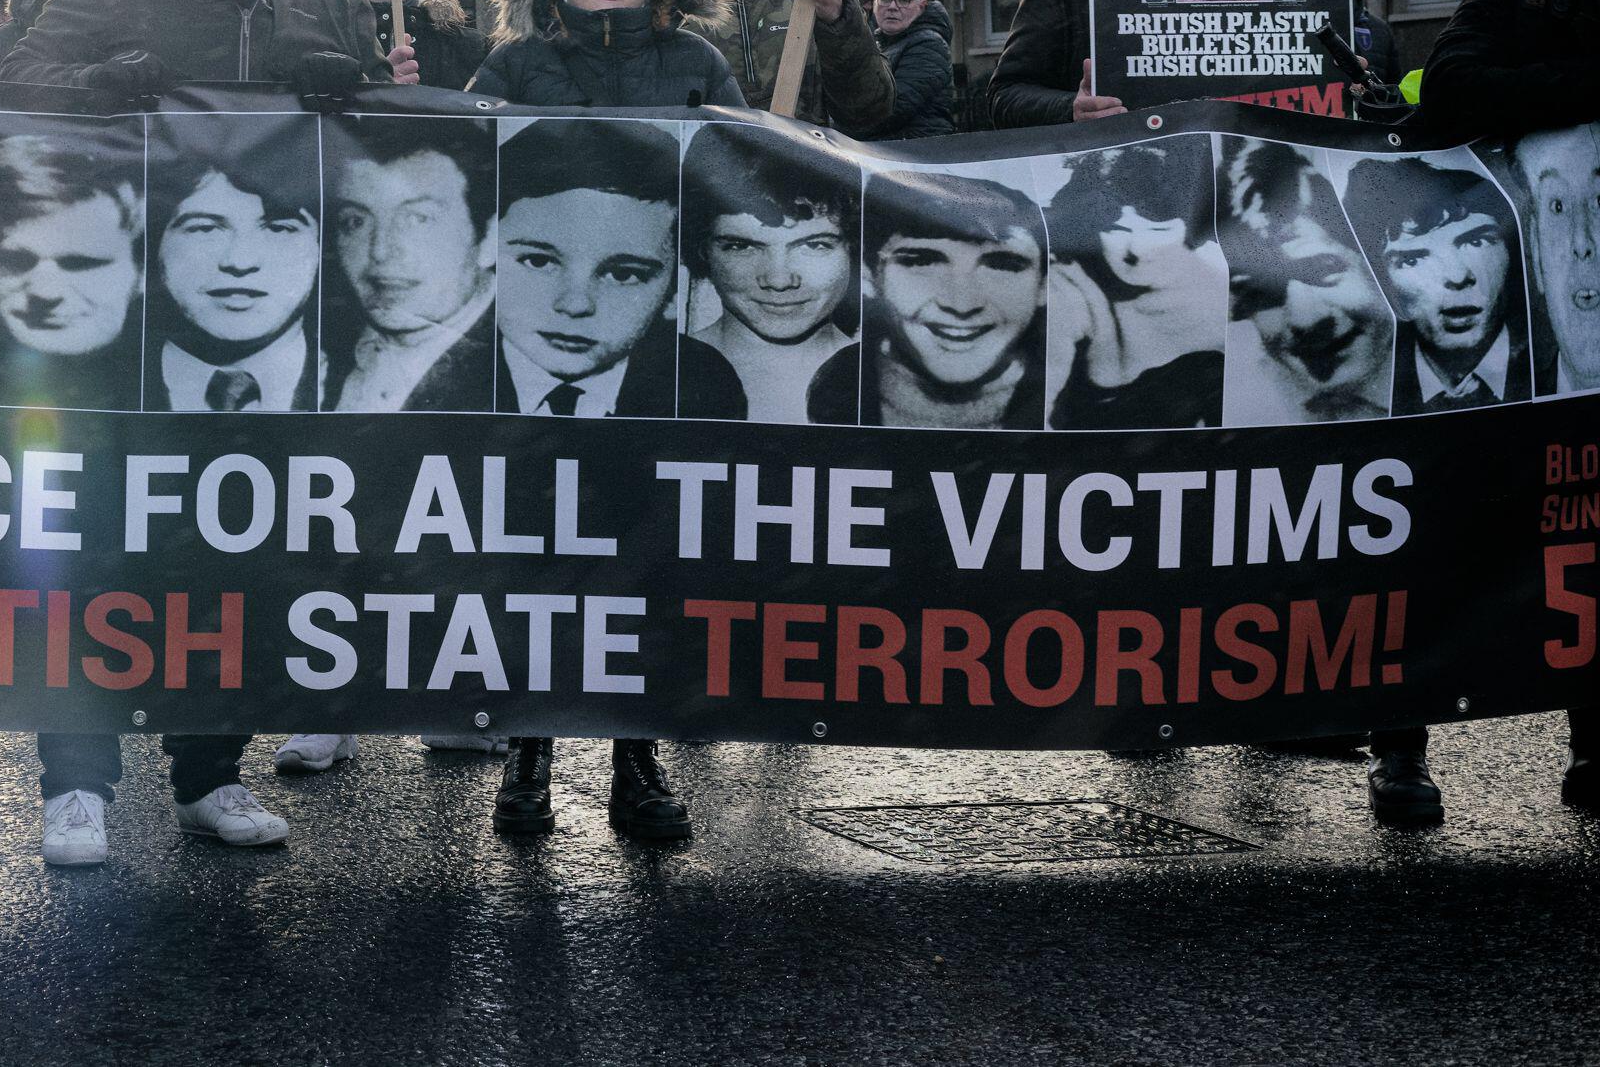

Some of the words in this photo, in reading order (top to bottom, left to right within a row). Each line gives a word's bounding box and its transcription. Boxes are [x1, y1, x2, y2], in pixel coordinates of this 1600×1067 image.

[1117, 13, 1223, 35] BRITISH
[1141, 34, 1250, 56] BULLETS
[1252, 33, 1311, 55] KILL
[1126, 55, 1198, 77] IRISH
[1199, 54, 1324, 77] CHILDREN
[124, 453, 361, 554] FOR
[393, 455, 618, 557] ALL
[655, 461, 893, 567] THE
[929, 458, 1414, 572] VICTIMS
[285, 590, 647, 694] STATE
[683, 589, 1408, 708] TERRORISM!
